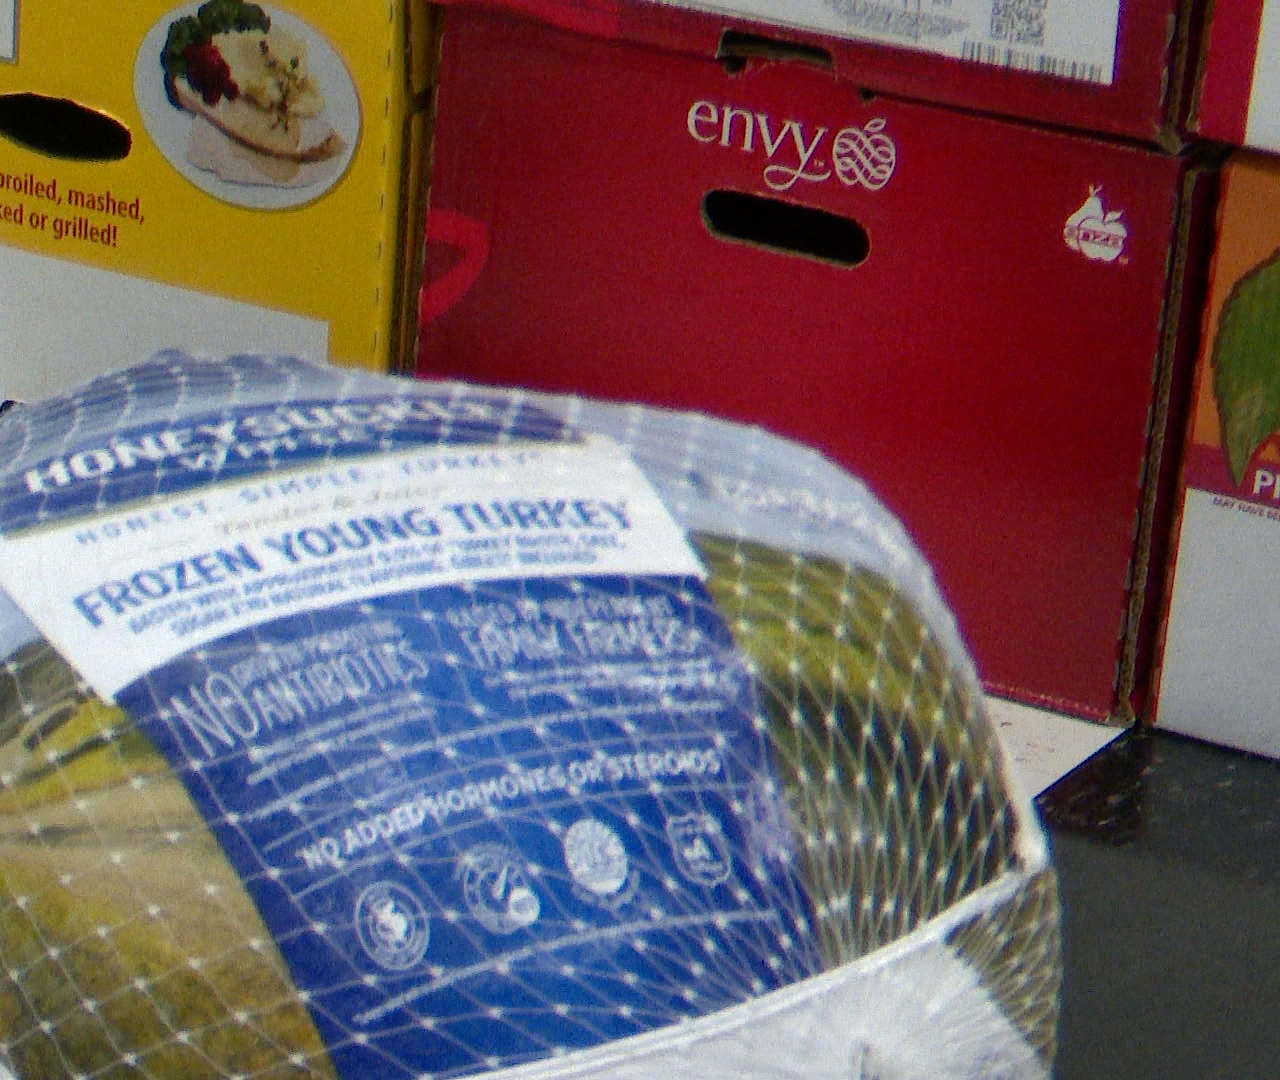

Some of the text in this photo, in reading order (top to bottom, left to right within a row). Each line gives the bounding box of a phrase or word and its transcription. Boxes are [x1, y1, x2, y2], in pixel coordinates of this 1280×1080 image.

[687, 100, 832, 190] envy
[29, 211, 48, 230] or
[53, 216, 118, 248] grilled!
[68, 188, 144, 225] mashed,
[73, 538, 264, 628] FROZEN
[264, 508, 440, 564] YOUNG
[444, 498, 633, 534] TURKEY
[169, 670, 259, 759] NO
[298, 838, 340, 872] NO
[342, 800, 426, 853] ADDED
